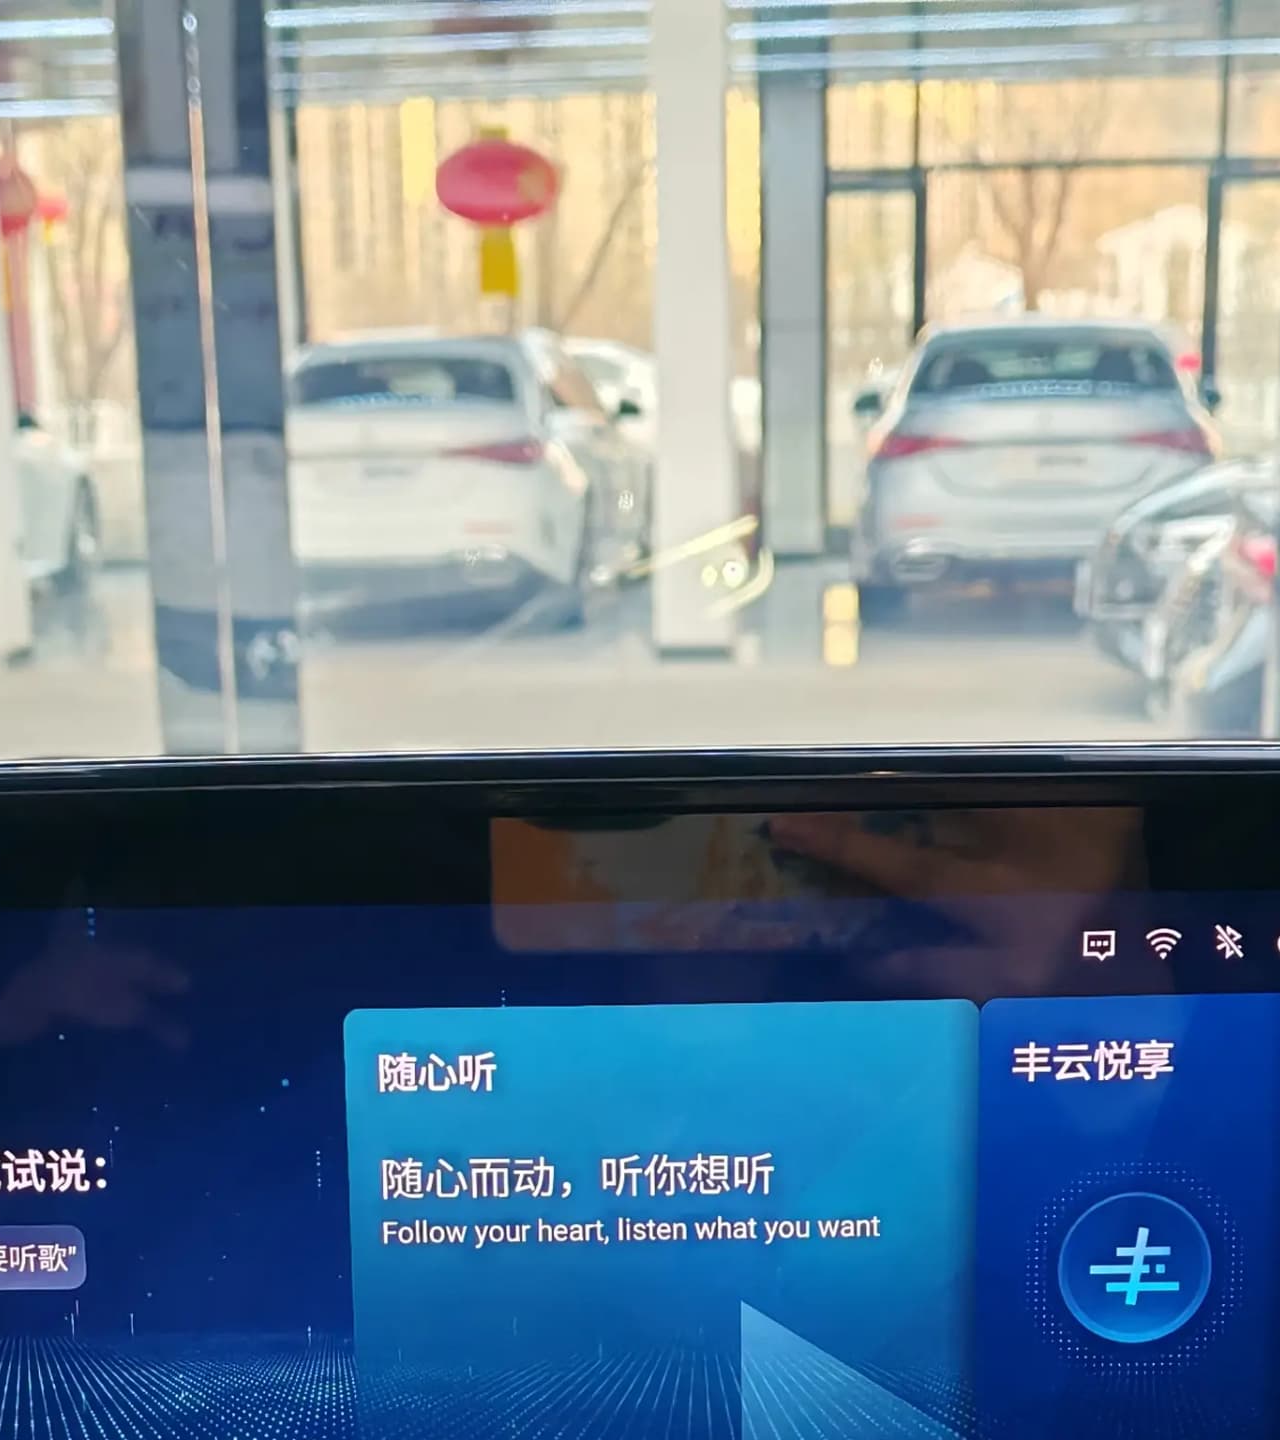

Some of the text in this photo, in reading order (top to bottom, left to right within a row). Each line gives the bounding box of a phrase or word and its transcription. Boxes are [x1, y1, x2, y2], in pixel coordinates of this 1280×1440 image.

[377, 1051, 498, 1094] 随心听
[1010, 1039, 1175, 1083] 丰云悦享
[380, 1152, 776, 1201] 随心而动，听你想听
[381, 1214, 882, 1249] Follow your heart, listen what you want
